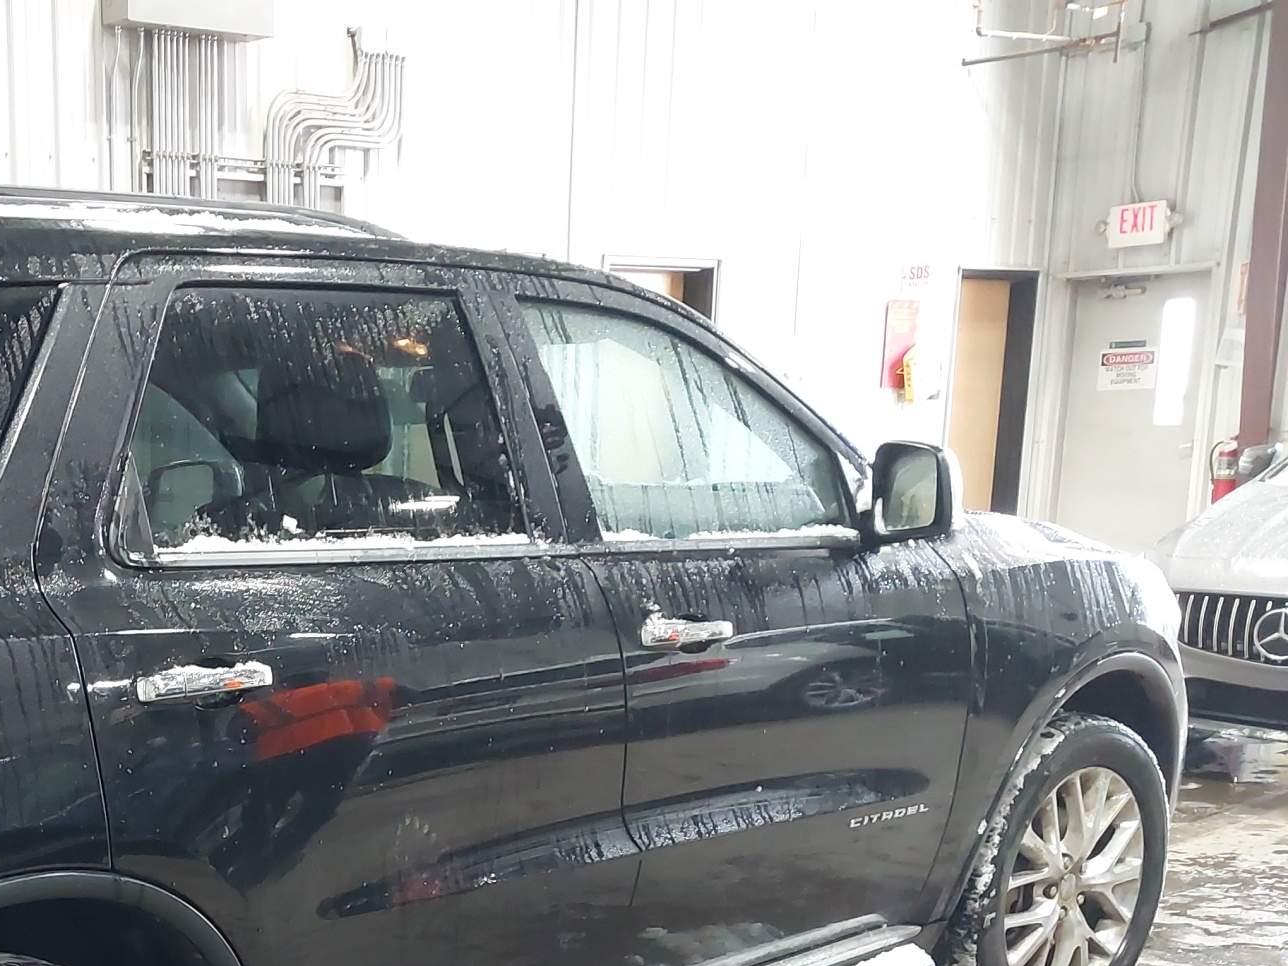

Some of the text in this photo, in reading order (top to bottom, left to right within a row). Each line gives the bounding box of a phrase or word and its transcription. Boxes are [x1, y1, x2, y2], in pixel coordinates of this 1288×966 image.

[1119, 204, 1158, 233] EXIT
[1108, 354, 1145, 363] DANGER
[849, 804, 929, 828] CITADEL
